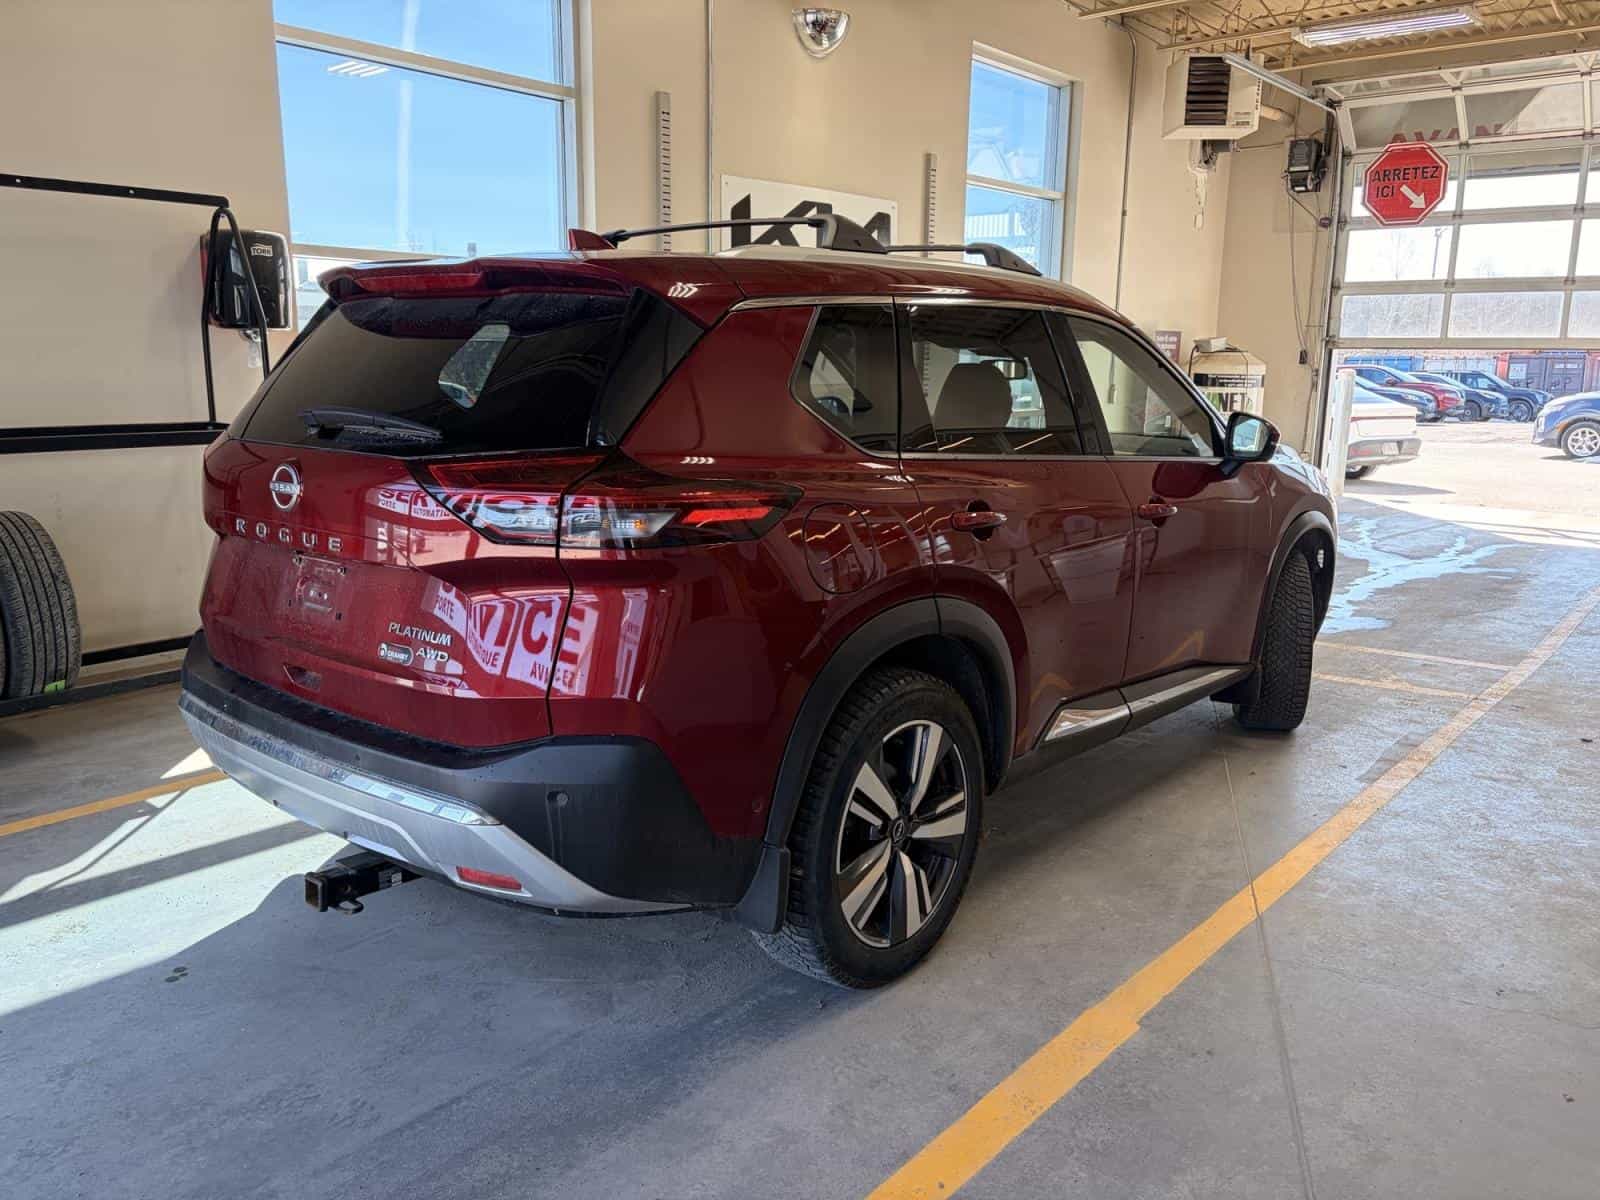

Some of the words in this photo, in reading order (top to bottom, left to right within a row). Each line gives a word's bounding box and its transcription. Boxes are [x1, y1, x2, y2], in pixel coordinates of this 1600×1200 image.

[1372, 166, 1441, 182] ARRETEZ
[1376, 186, 1396, 199] ICI
[236, 518, 342, 552] ROGUE
[388, 621, 451, 647] PLATINUM
[416, 647, 449, 662] AWD
